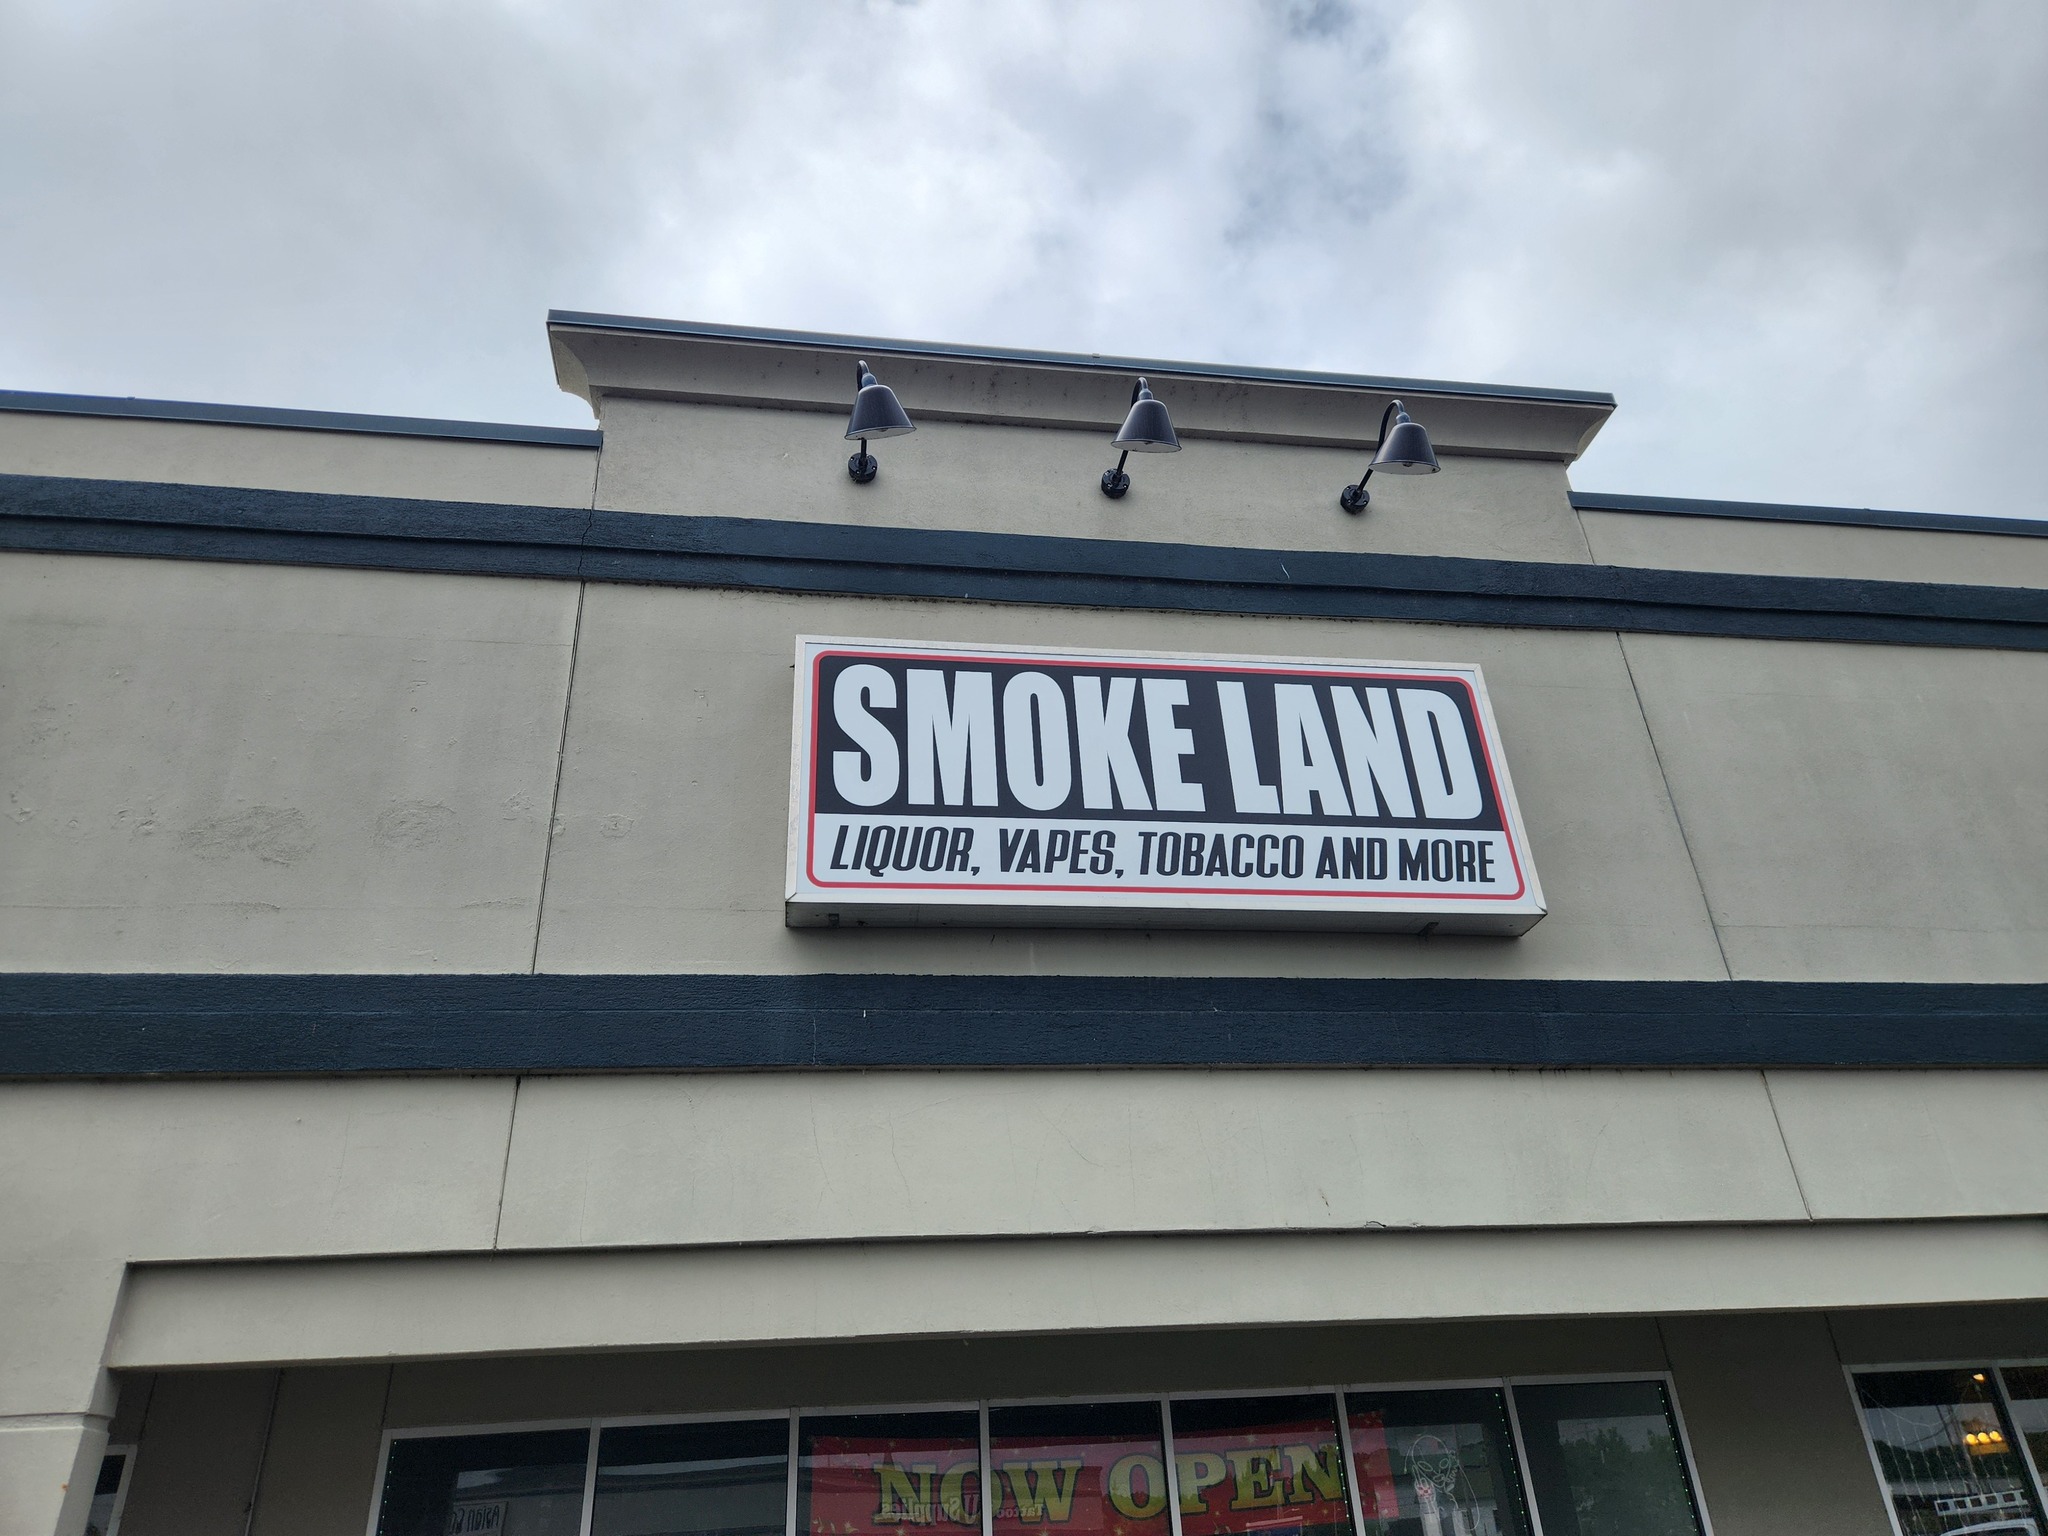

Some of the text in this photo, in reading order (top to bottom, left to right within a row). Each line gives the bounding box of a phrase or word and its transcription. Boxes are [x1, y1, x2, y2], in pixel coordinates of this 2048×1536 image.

[832, 663, 1484, 820] SMOKE LAND
[829, 824, 1496, 883] LIQUOR, VAPES, TOBACCO AND MORE
[872, 1446, 1346, 1526] NOW OPEN
